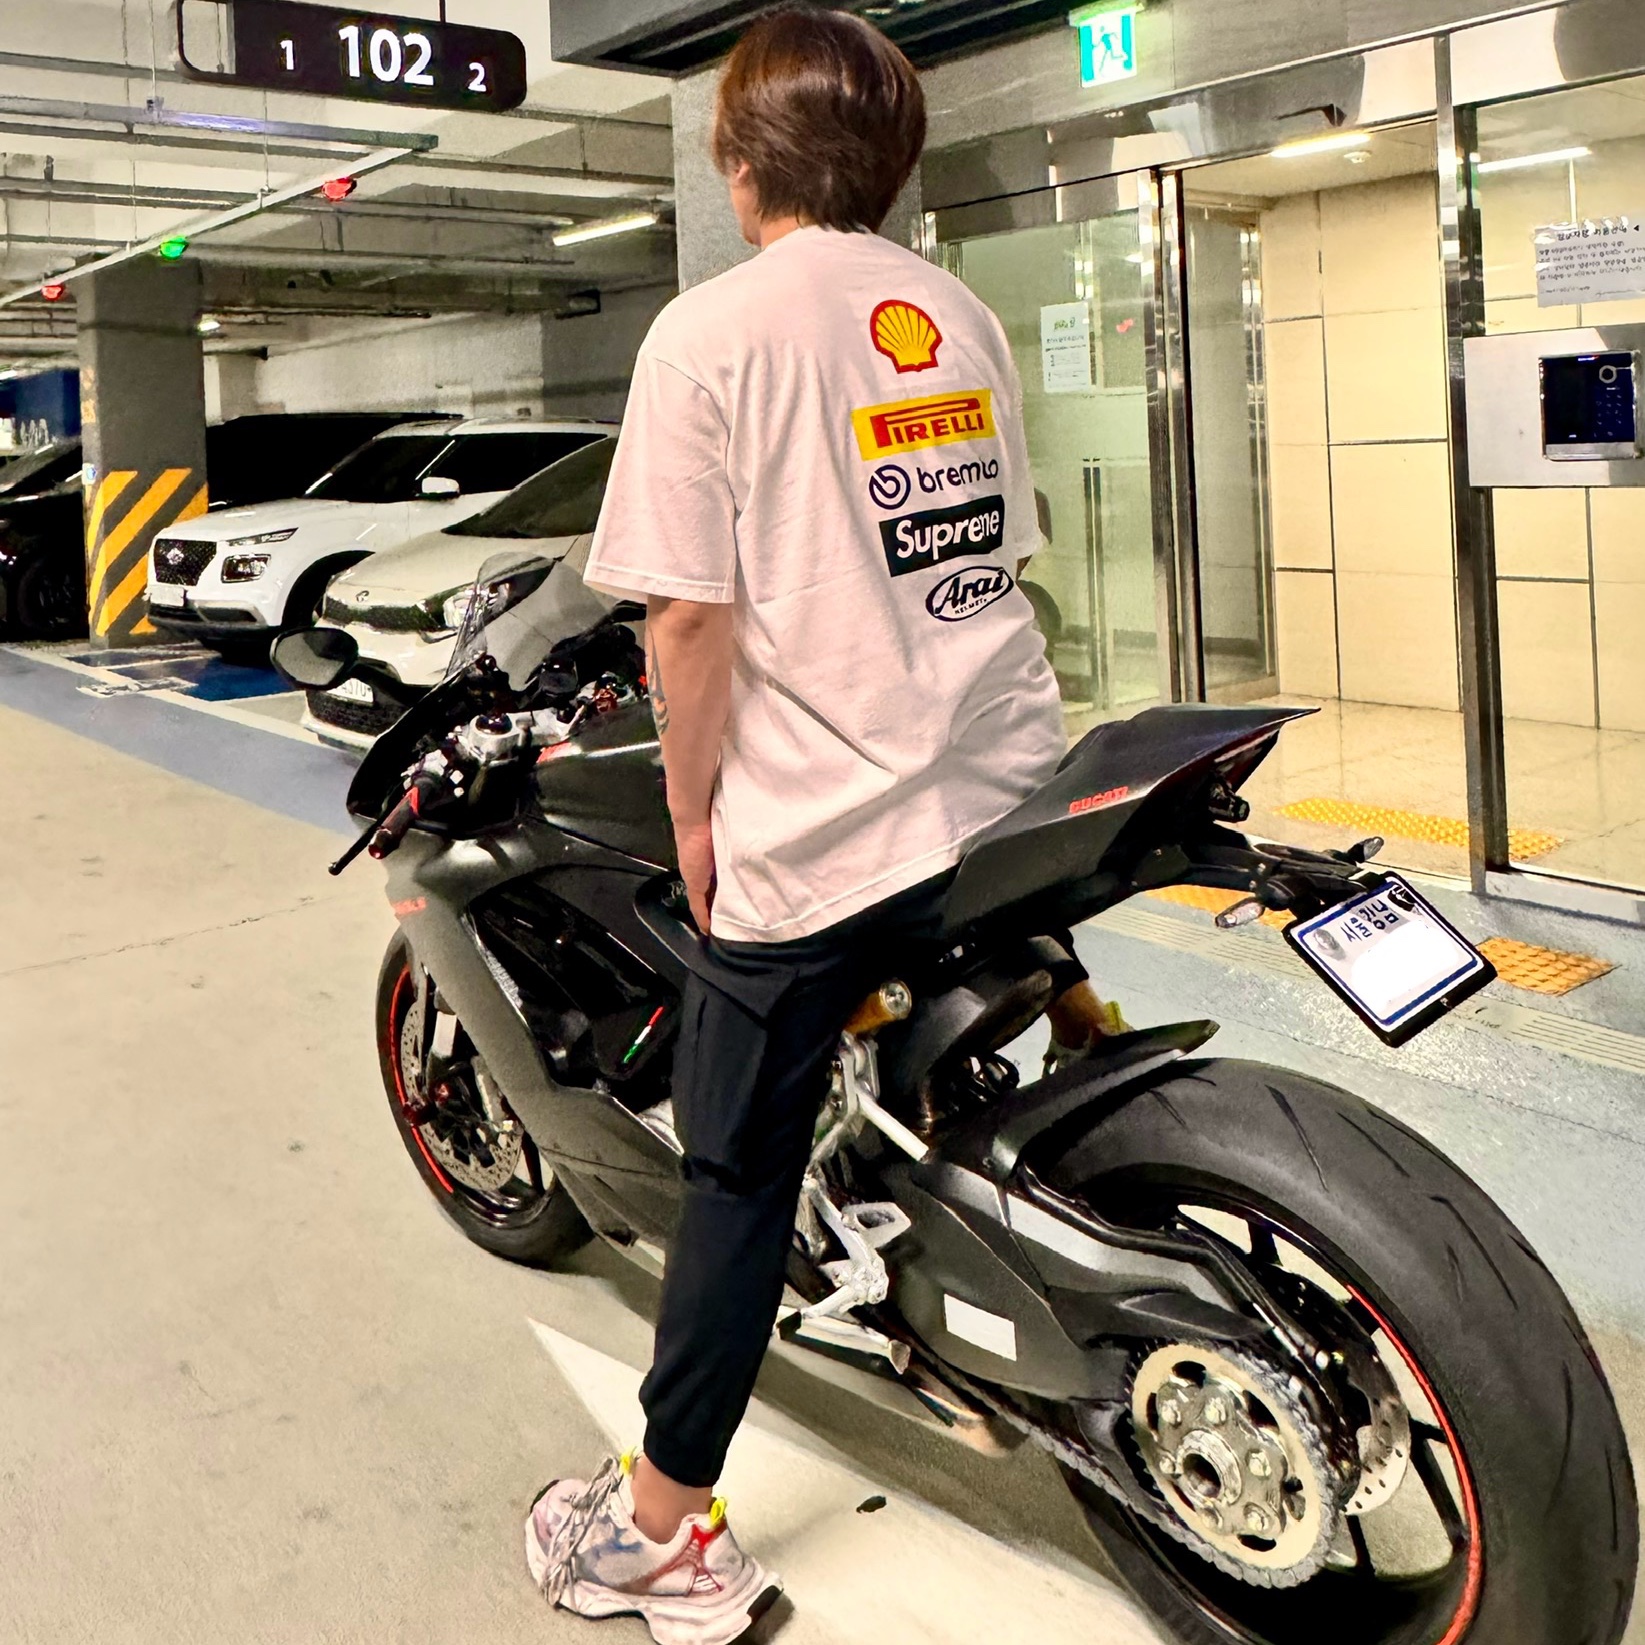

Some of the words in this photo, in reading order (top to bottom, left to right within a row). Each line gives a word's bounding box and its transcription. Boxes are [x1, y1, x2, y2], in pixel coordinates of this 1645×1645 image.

[281, 39, 295, 70] 1
[338, 25, 434, 86] 102
[467, 62, 487, 92] 2
[870, 398, 984, 448] PIRELLI
[934, 570, 1003, 614] Arai
[1340, 917, 1372, 942] 서울
[1359, 899, 1399, 930] 강남
